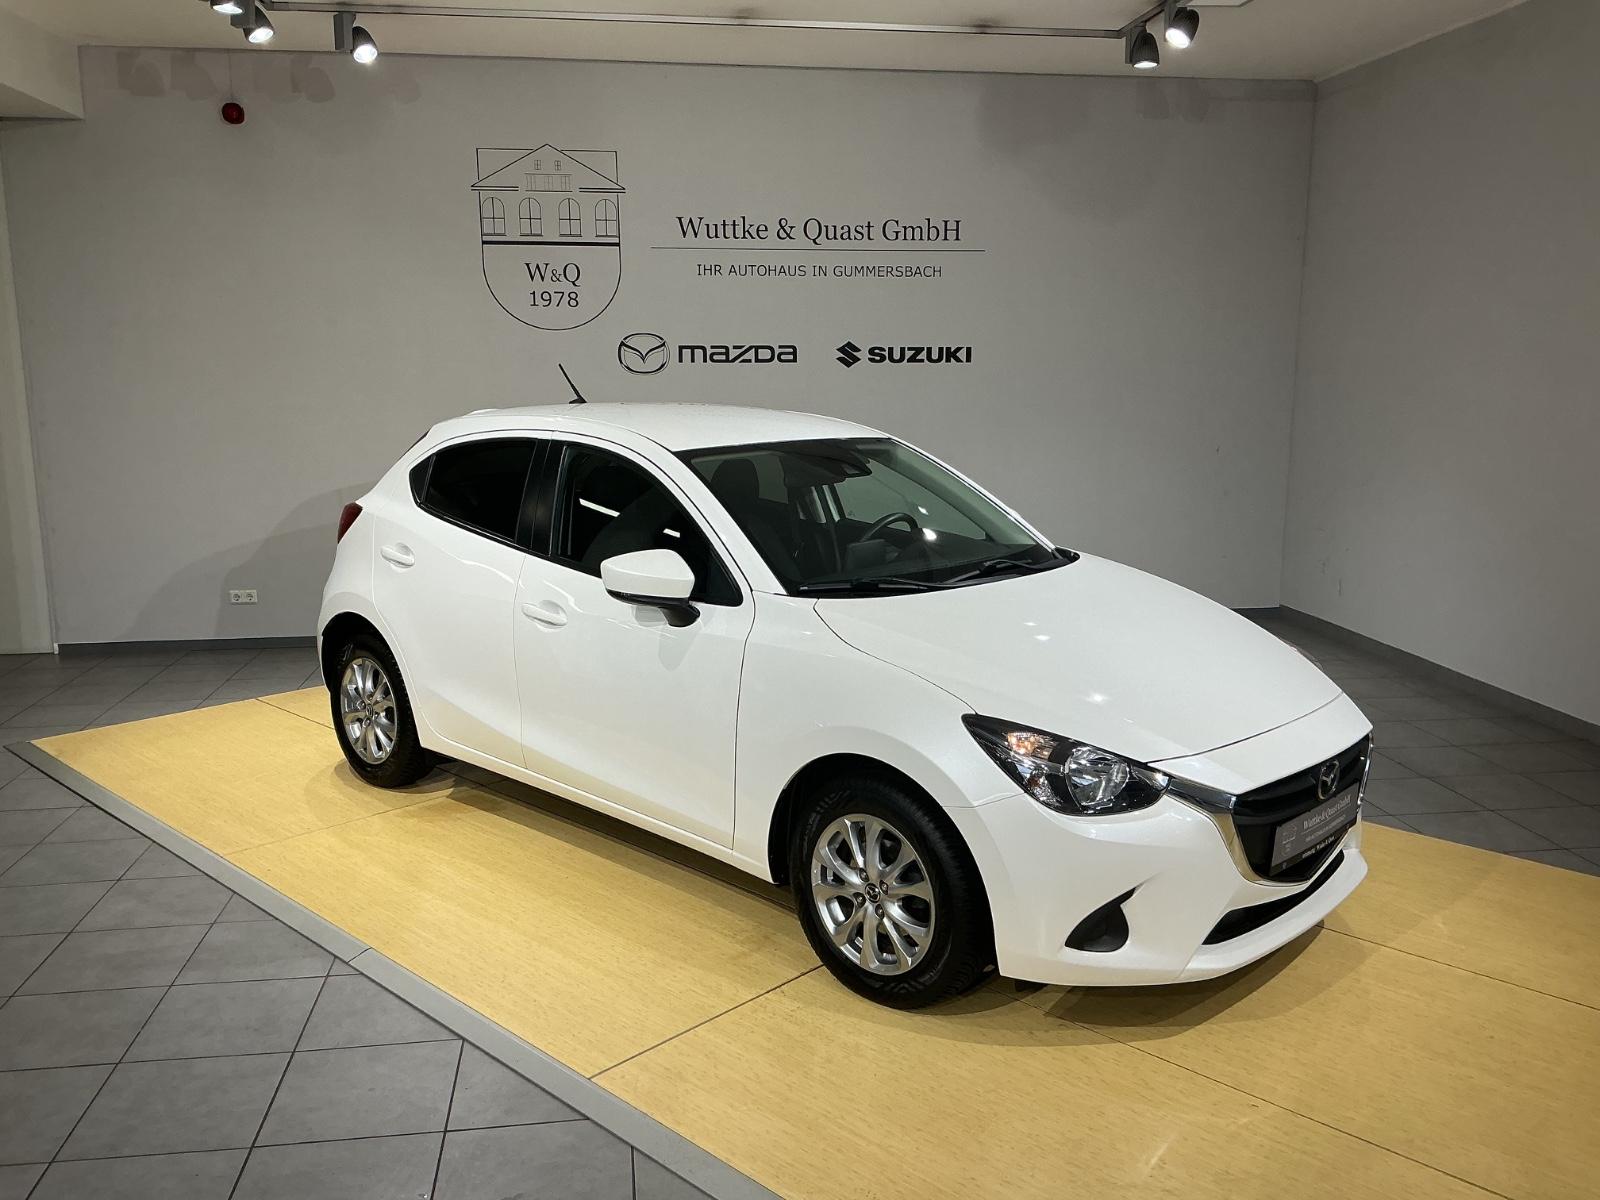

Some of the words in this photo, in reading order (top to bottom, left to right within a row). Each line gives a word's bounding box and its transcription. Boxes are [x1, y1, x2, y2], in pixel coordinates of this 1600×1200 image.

[676, 216, 769, 241] Wuttke
[776, 217, 797, 241] &
[802, 217, 875, 246] Quast
[882, 217, 962, 242] GmbH
[524, 262, 582, 287] W&Q
[697, 263, 723, 277] IHR
[728, 264, 807, 278] AUTOHAUS
[812, 265, 828, 278] IN
[832, 264, 942, 279] GUMMERSBACH
[529, 290, 580, 308] 1978
[867, 346, 973, 364] SUZUKI
